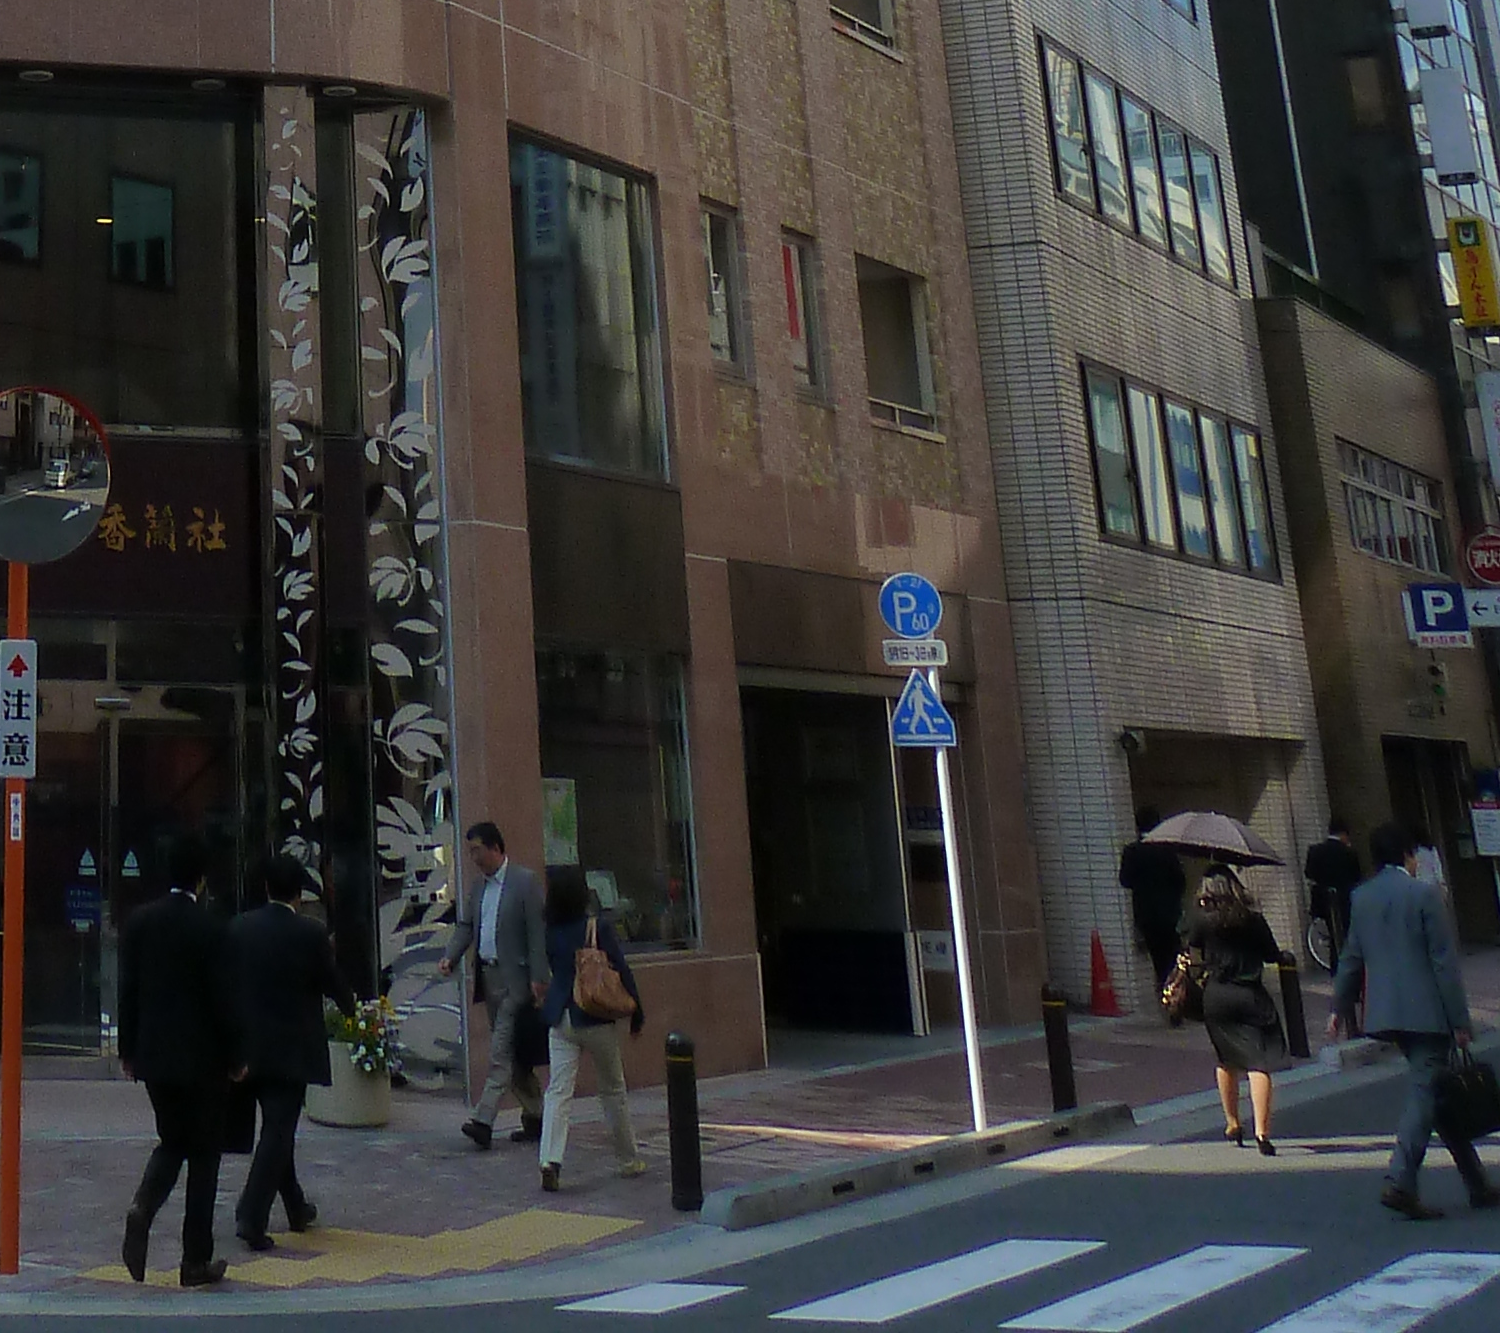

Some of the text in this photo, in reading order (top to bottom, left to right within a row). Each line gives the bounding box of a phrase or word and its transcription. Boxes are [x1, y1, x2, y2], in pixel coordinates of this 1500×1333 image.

[893, 591, 917, 632] P
[912, 612, 930, 631] 60
[1422, 590, 1454, 627] P
[2, 689, 31, 767] 注意
